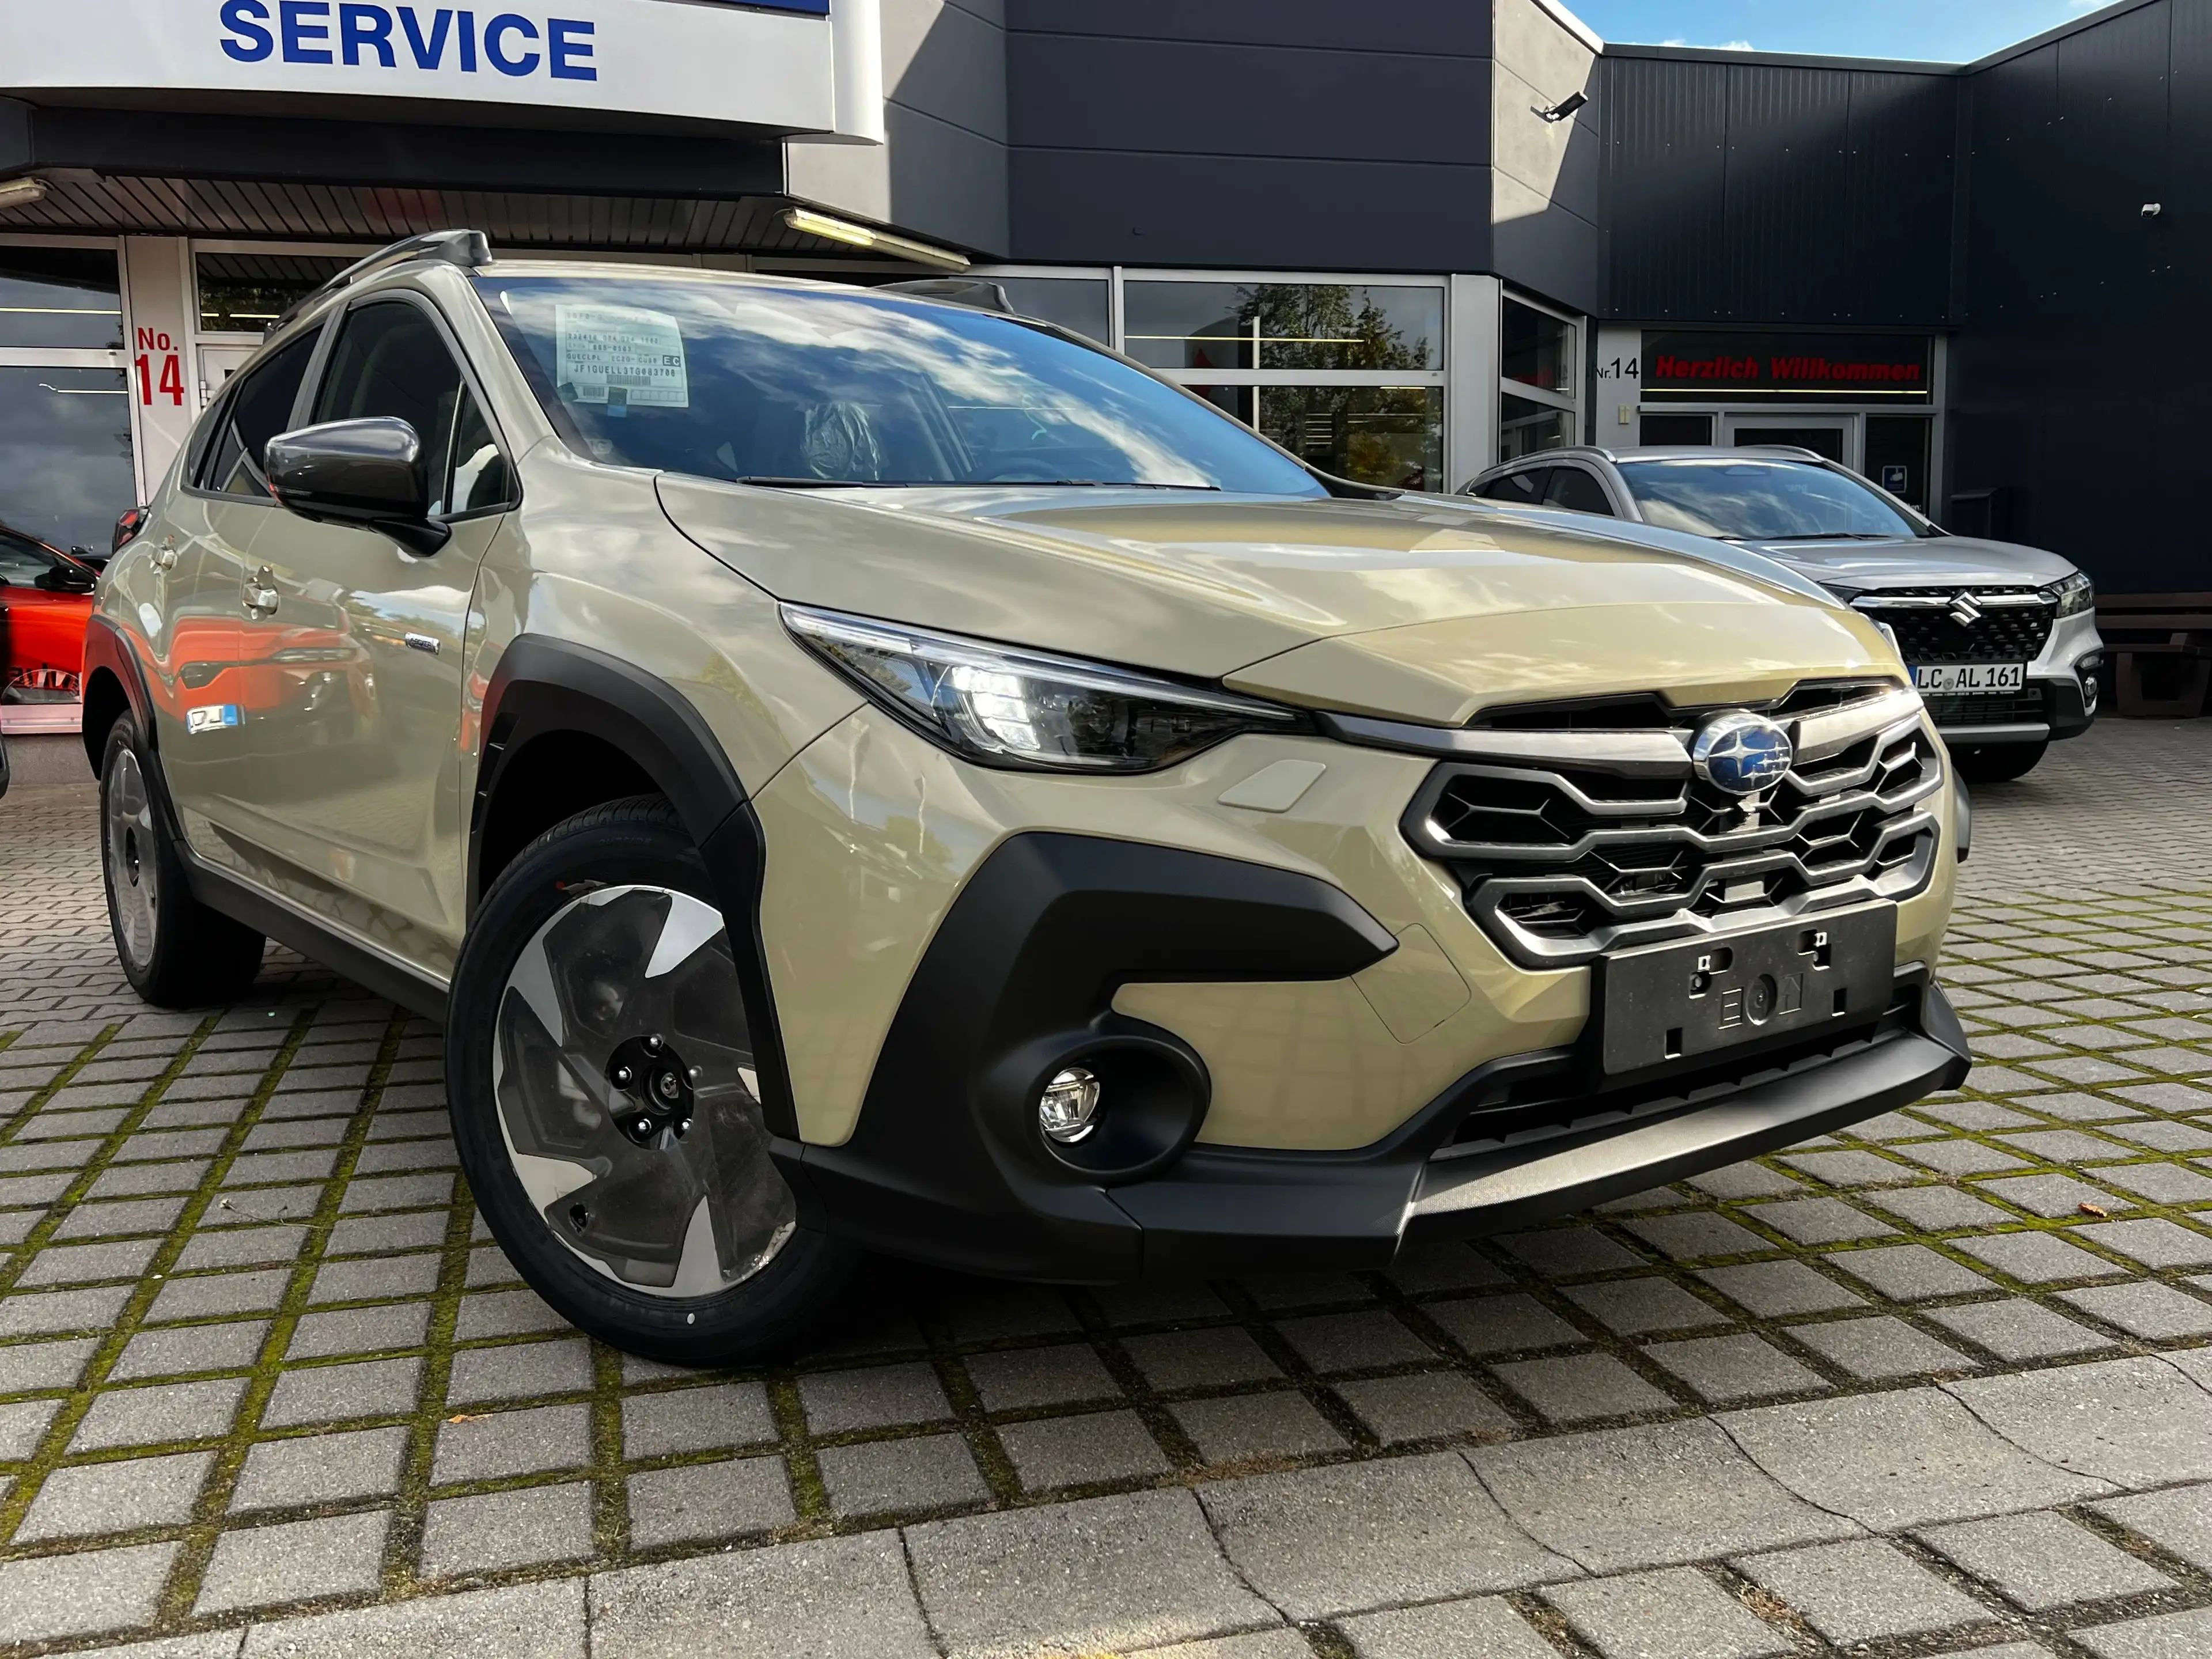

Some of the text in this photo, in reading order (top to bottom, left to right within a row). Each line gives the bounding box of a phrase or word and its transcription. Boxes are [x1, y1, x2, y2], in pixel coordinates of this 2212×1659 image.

[219, 0, 597, 81] SERVICE
[137, 327, 179, 351] No.
[664, 356, 680, 366] EC
[1656, 355, 1921, 381] Herzlich Willkommen
[135, 353, 184, 406] 14
[1917, 666, 2021, 690] LC AL 161
